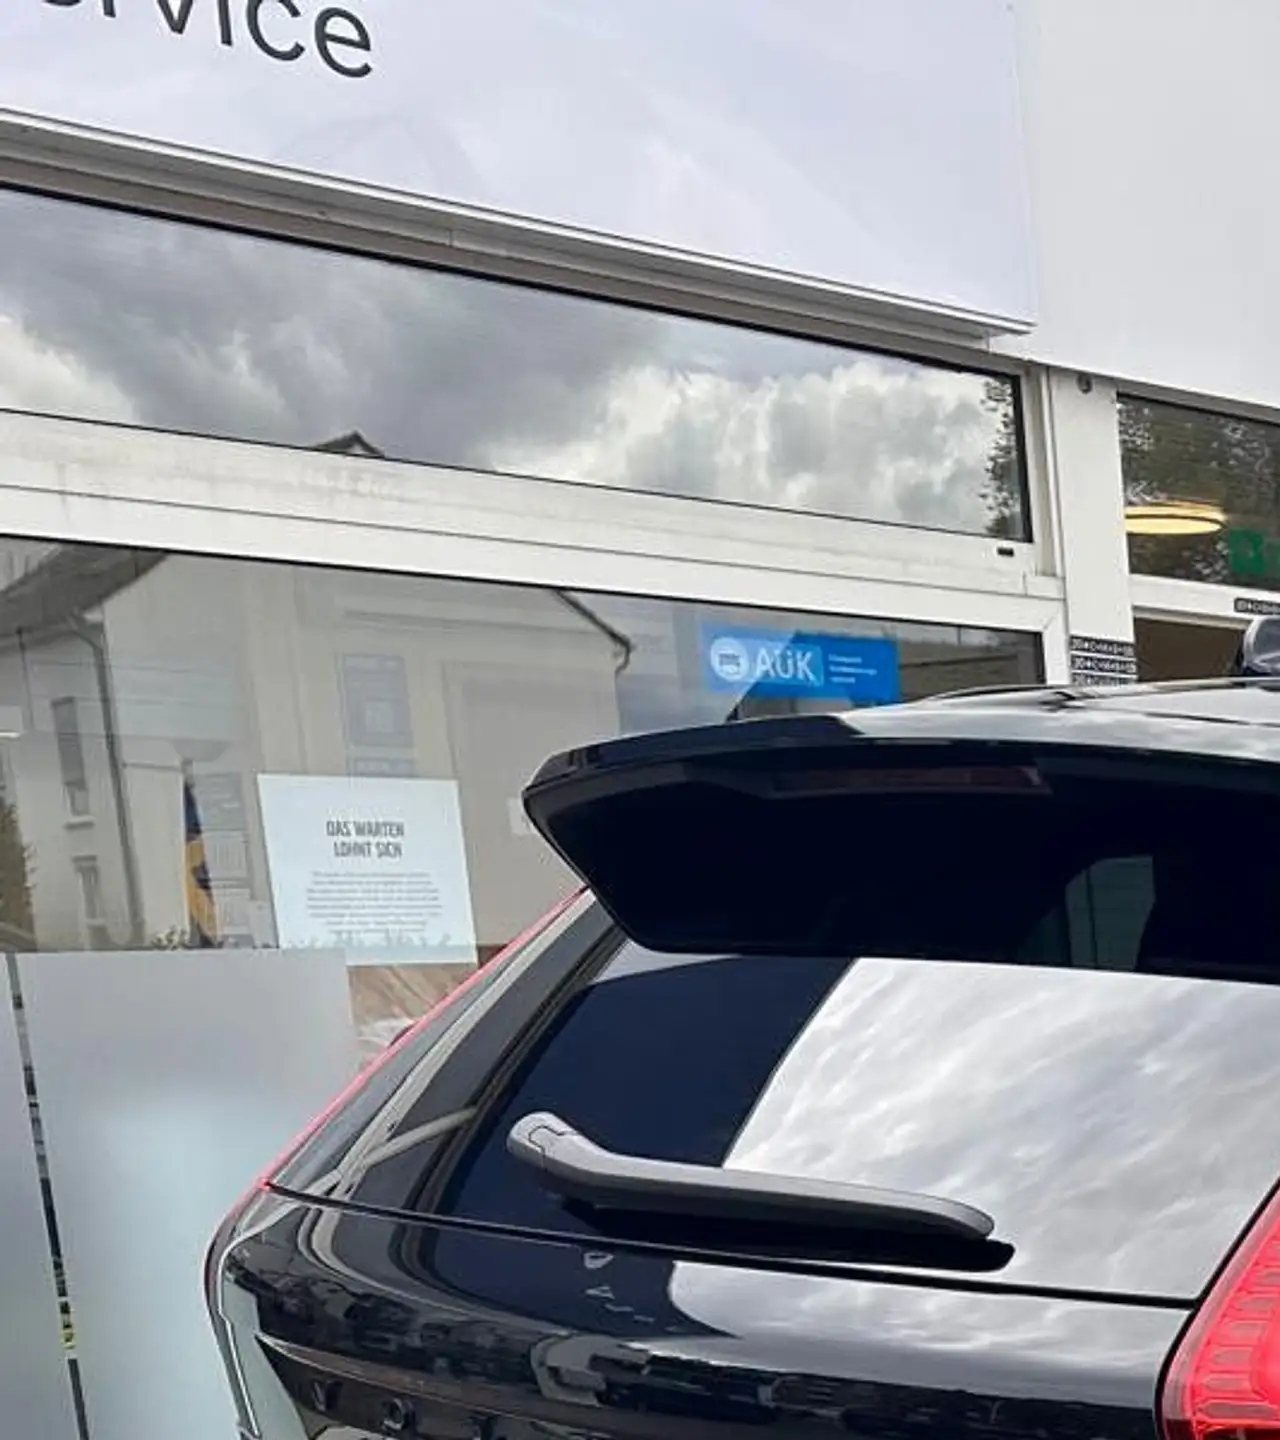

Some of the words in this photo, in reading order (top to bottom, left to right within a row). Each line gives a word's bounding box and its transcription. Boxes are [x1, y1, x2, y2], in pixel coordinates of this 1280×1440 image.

[326, 821, 351, 837] DAS
[354, 821, 405, 838] WARTEN
[334, 841, 371, 857] LOHNT
[375, 842, 402, 858] SICH
